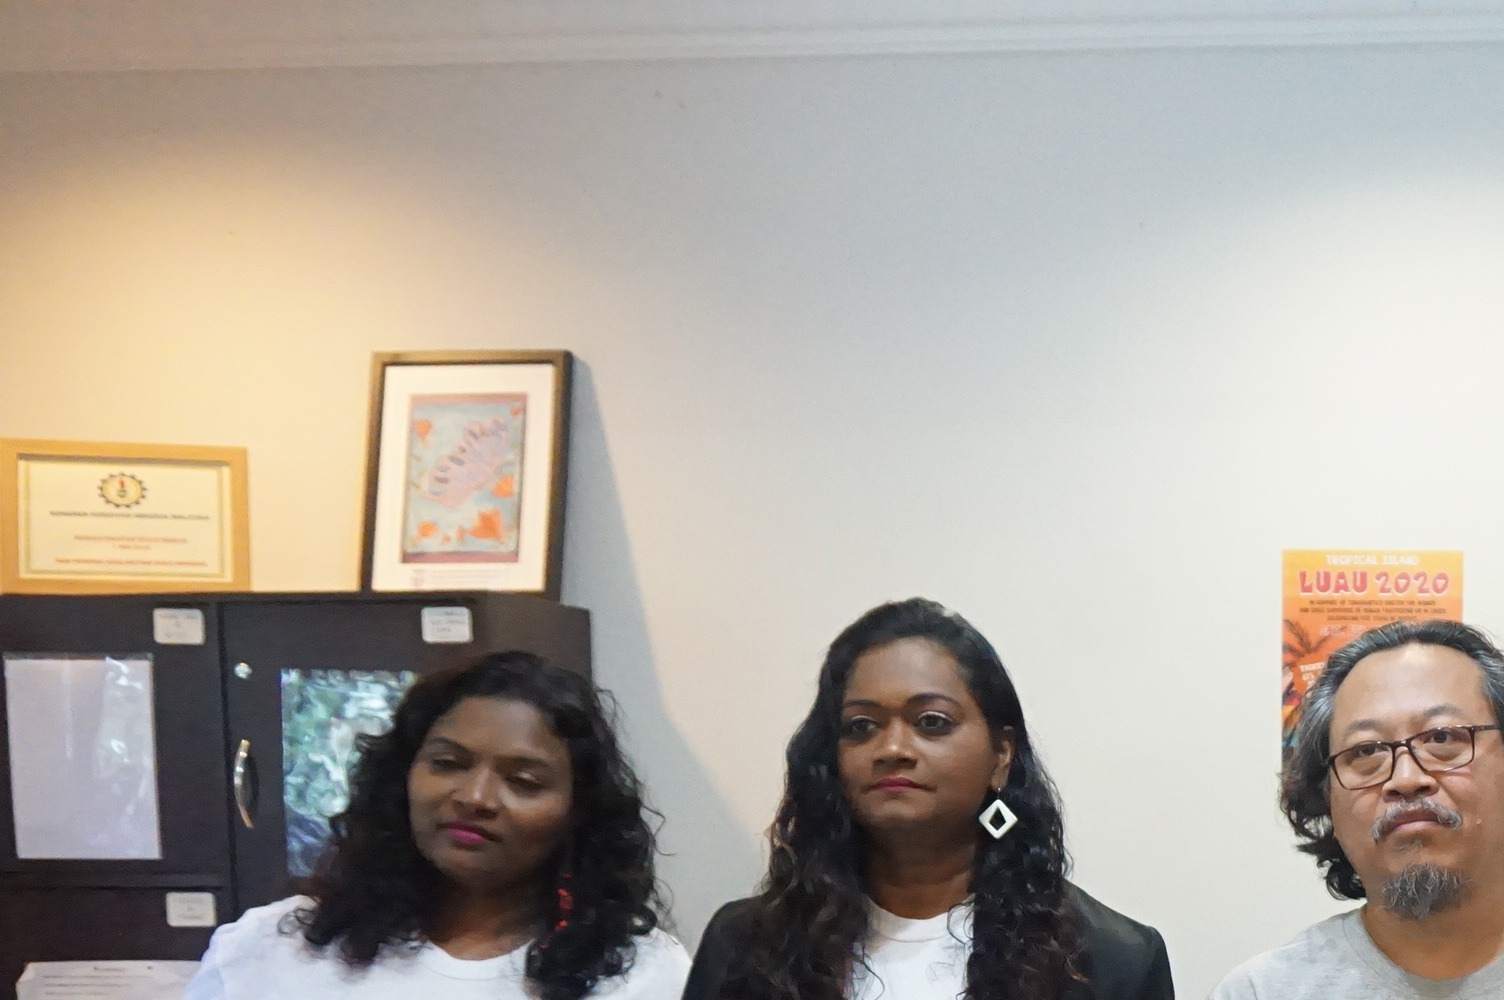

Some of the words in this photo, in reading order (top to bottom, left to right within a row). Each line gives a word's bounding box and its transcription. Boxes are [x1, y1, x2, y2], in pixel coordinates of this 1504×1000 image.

[1326, 554, 1378, 565] TROPICAL
[1382, 554, 1420, 565] ISLAND
[1299, 570, 1368, 595] LUAU
[1374, 570, 1450, 595] 2020
